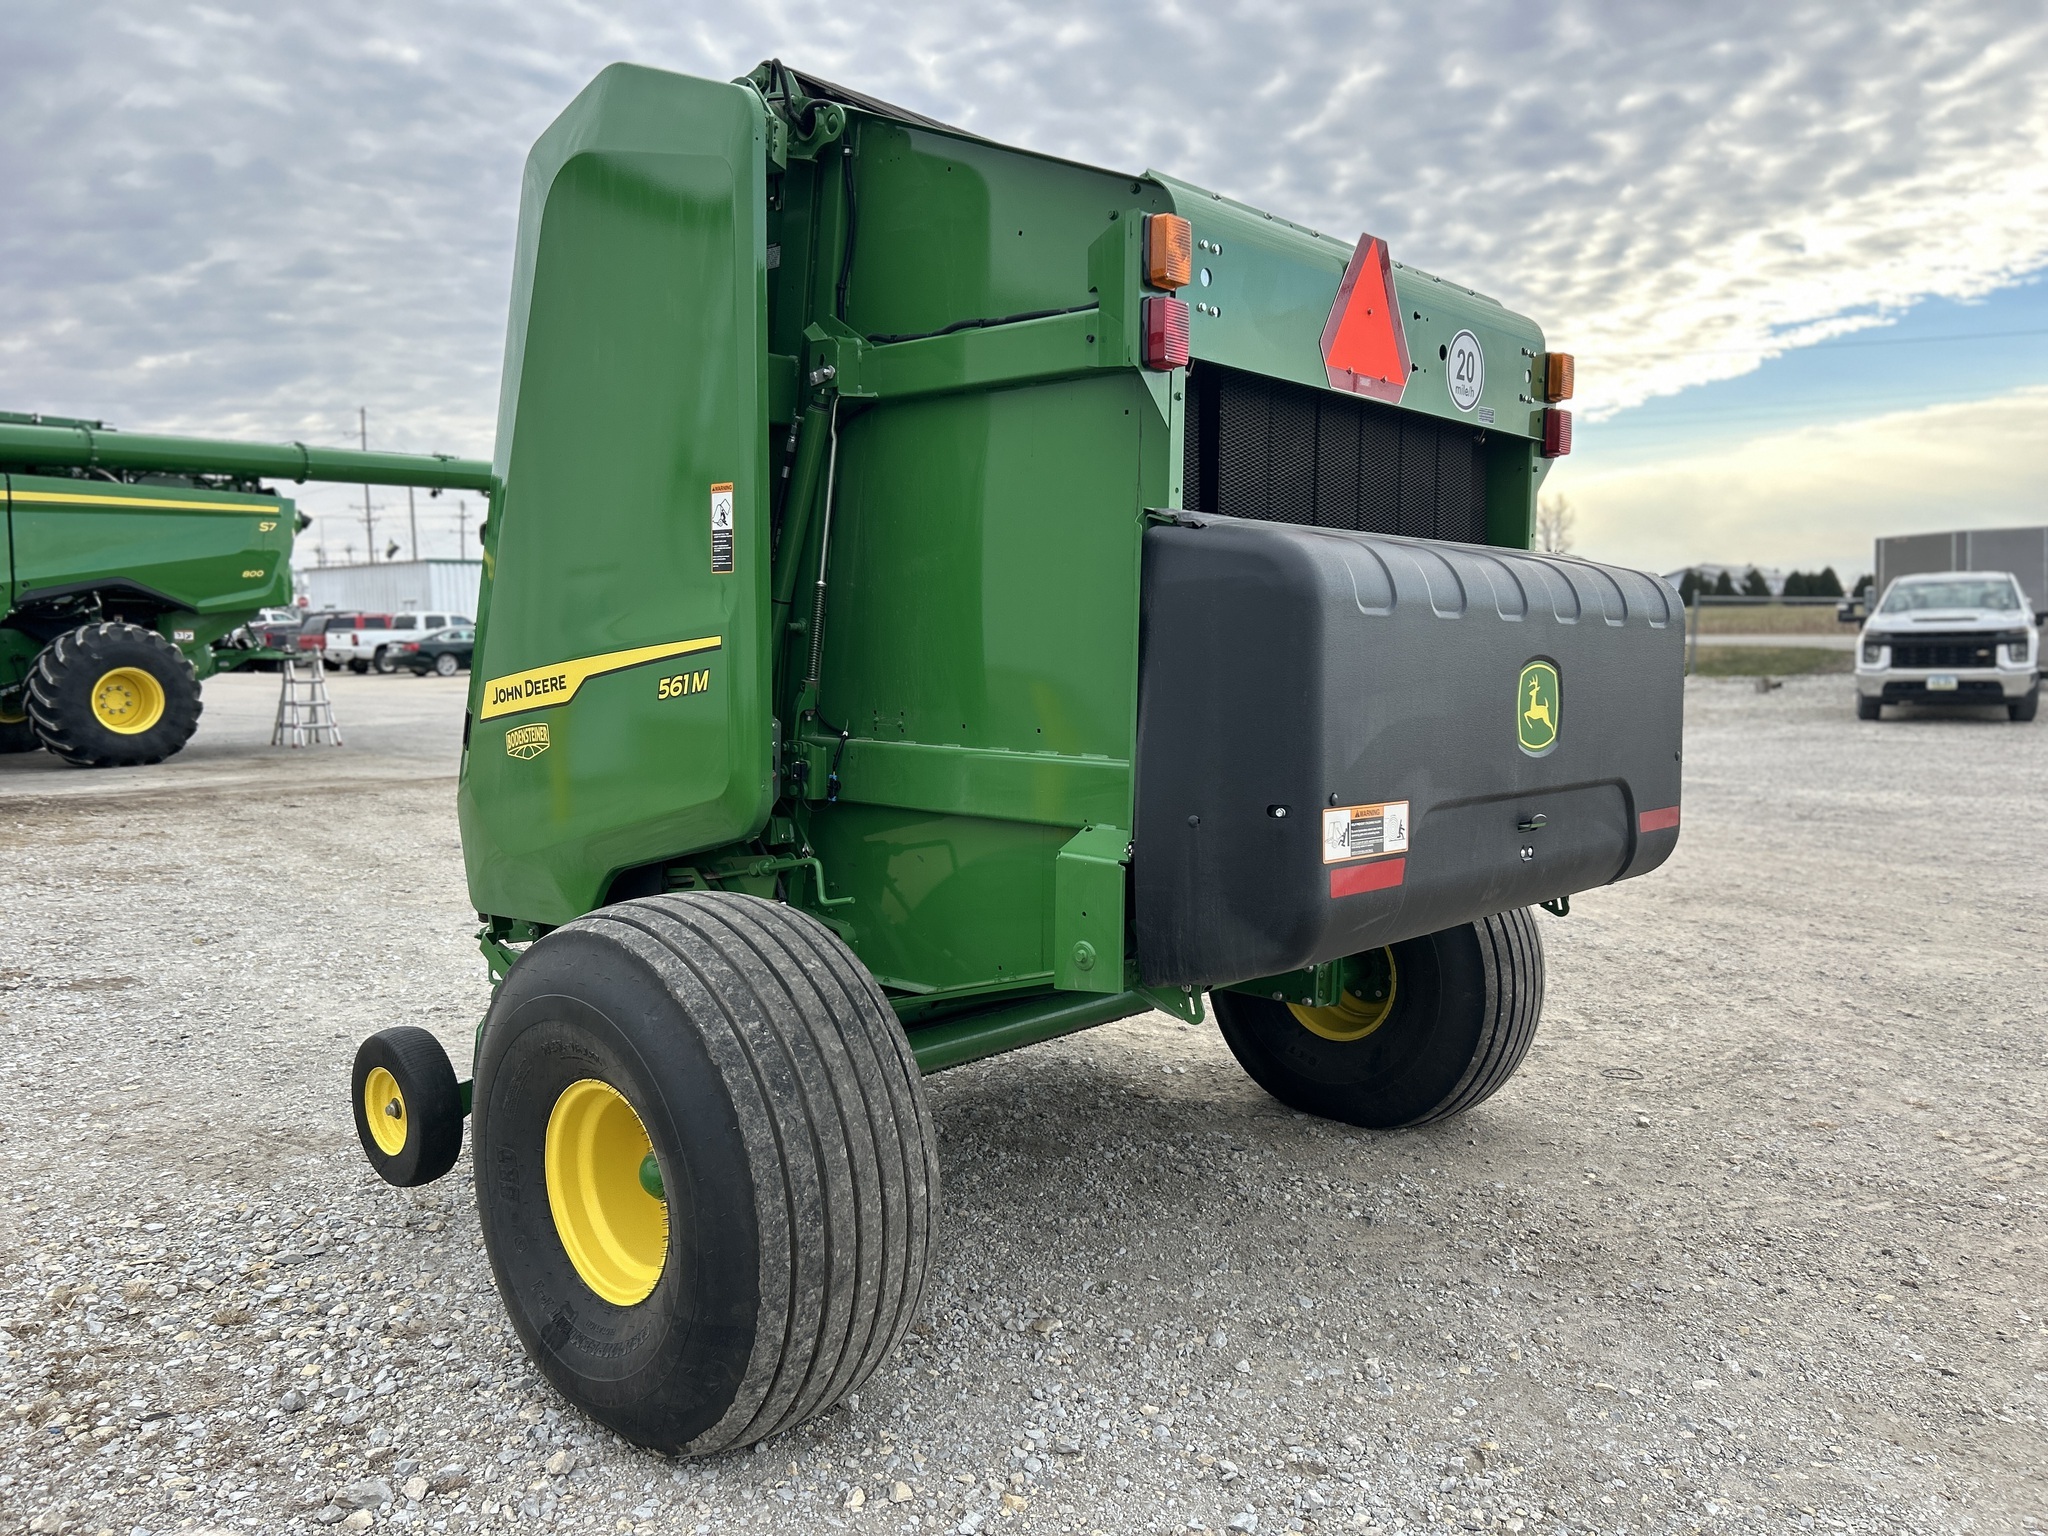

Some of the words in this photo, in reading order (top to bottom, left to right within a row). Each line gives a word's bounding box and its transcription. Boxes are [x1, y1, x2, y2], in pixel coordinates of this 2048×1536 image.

[1456, 348, 1475, 383] 20
[1455, 384, 1475, 397] mile/h
[714, 484, 733, 492] WARNING
[258, 521, 278, 533] S7
[241, 569, 265, 578] 800
[492, 684, 523, 705] JOHN
[525, 674, 568, 698] DEERE
[657, 673, 690, 700] 561
[691, 668, 711, 693] M
[506, 725, 549, 750] BODENSTEINER
[1359, 808, 1381, 818] WARNING
